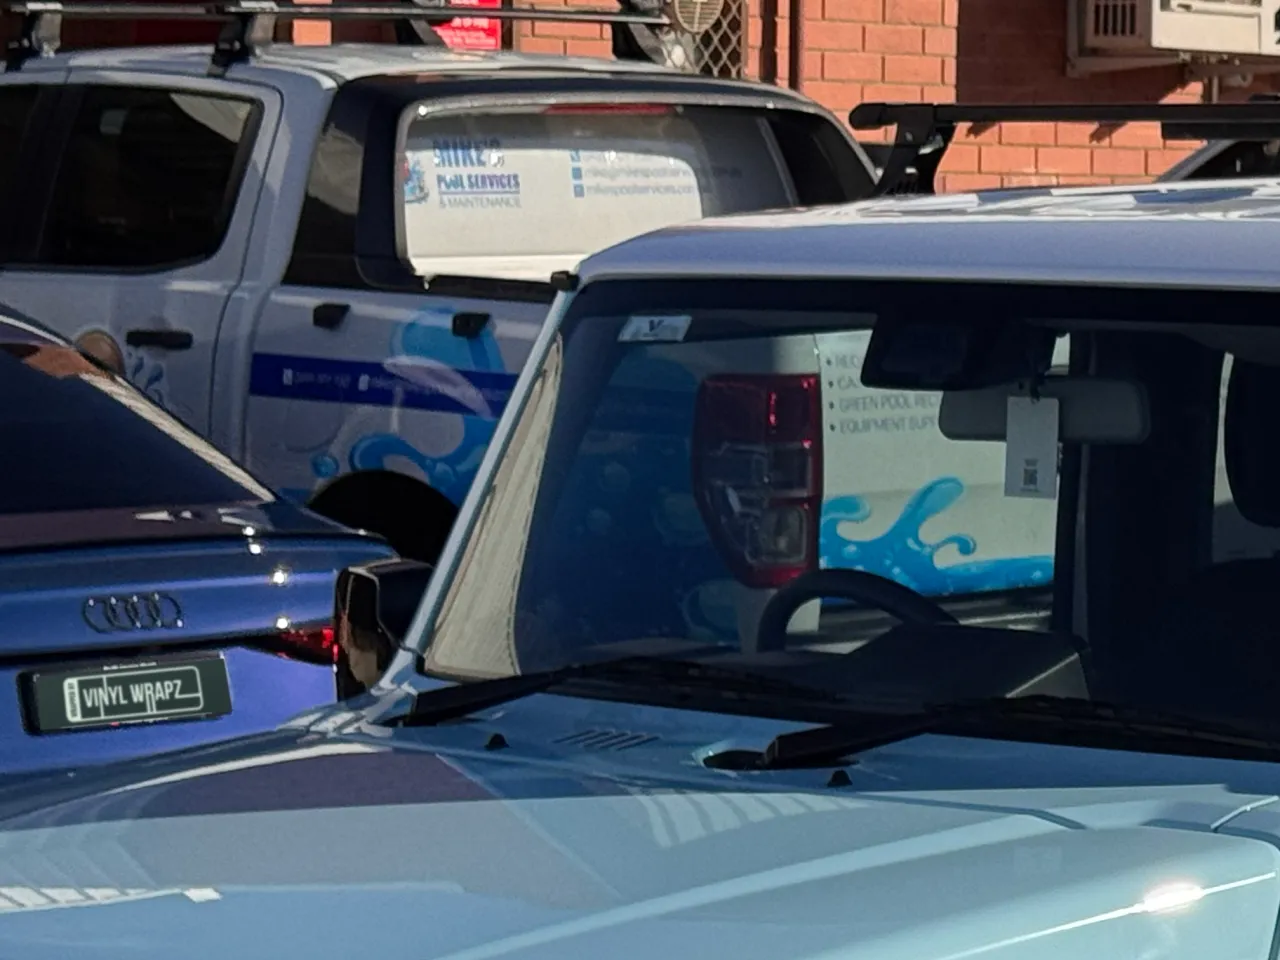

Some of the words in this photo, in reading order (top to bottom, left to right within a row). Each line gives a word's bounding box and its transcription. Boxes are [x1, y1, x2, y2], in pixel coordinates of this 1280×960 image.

[467, 173, 521, 190] SERVICES
[448, 196, 522, 209] MAINTENANCE
[82, 681, 129, 708] VINYL
[130, 679, 182, 705] WRAPZ
